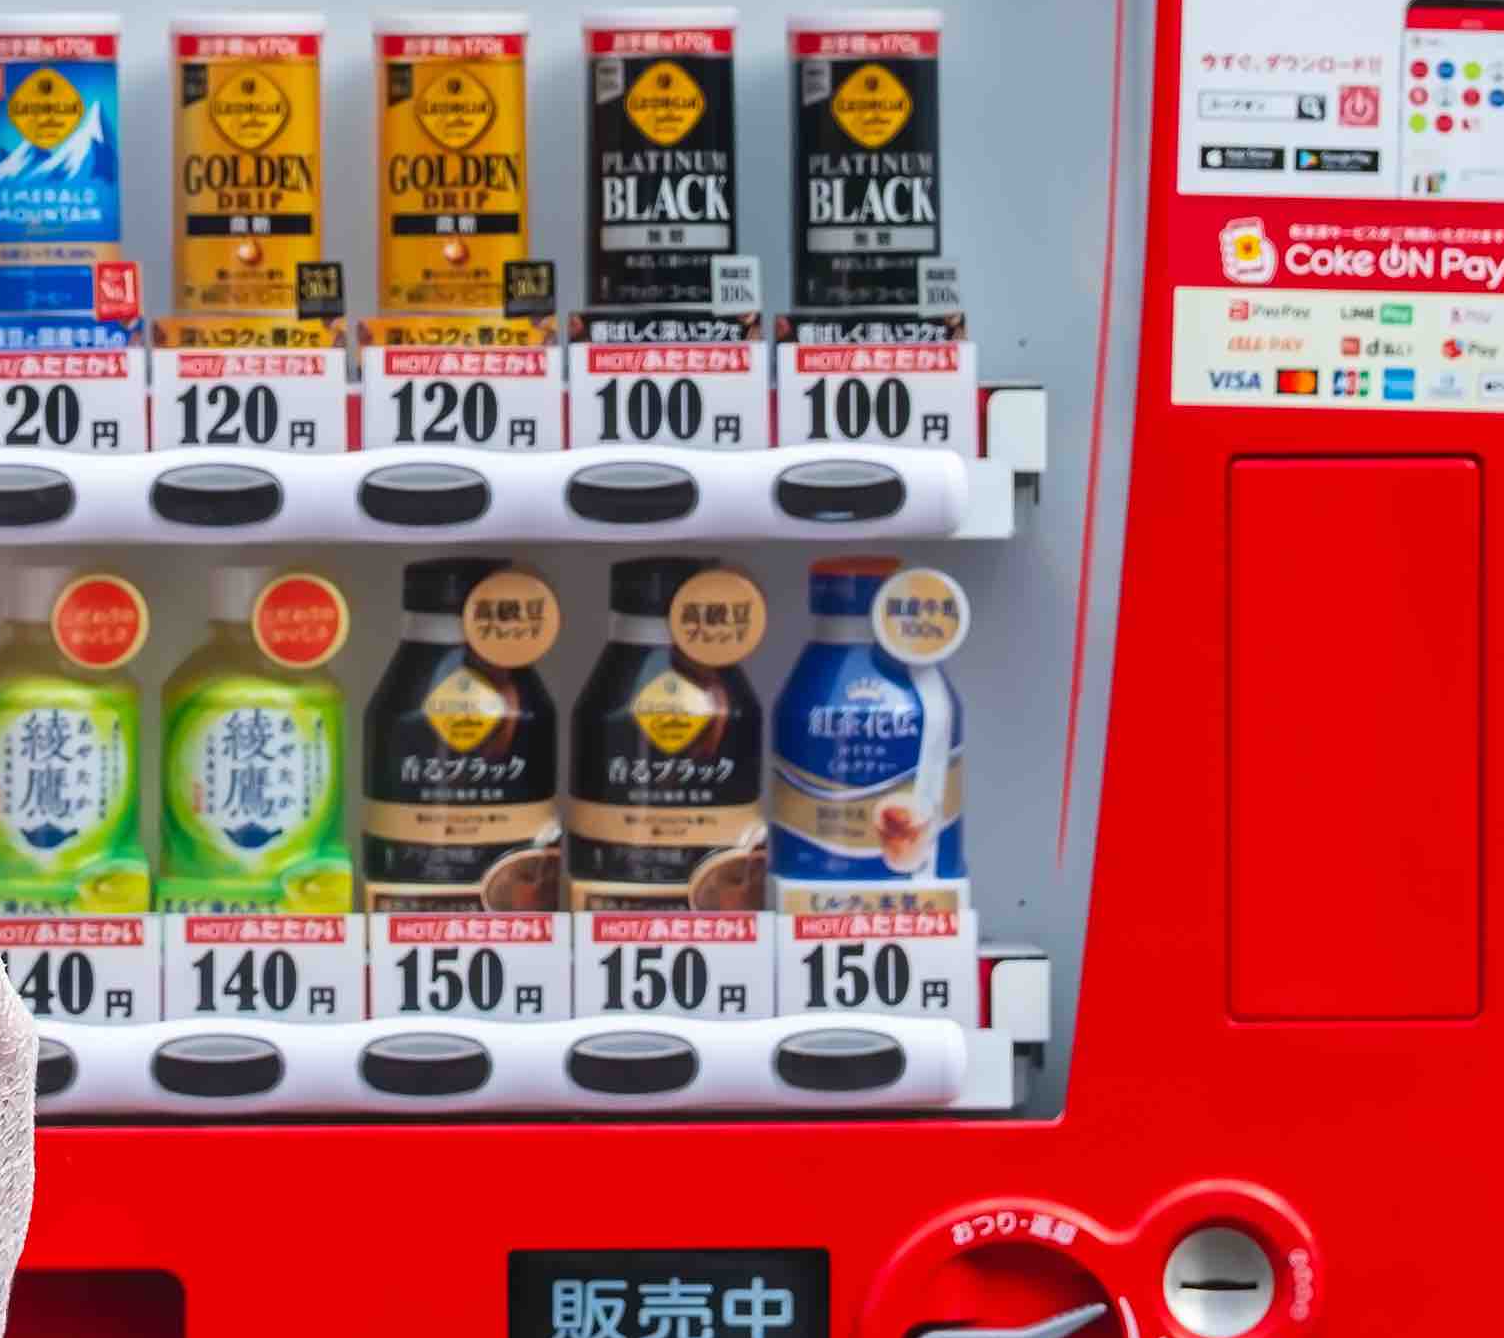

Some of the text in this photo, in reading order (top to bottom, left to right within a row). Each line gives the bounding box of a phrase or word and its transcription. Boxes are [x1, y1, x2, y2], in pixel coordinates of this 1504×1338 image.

[183, 153, 313, 196] GOLDEN
[389, 153, 519, 196] GOLDEN
[601, 151, 728, 174] PLATINUM
[808, 153, 934, 175] PLATINUM
[0, 189, 97, 204] EMERALD
[217, 192, 283, 209] DRIP
[423, 192, 488, 209] DRIP
[602, 175, 731, 221] BLACK
[808, 176, 936, 223] BLACK
[1284, 242, 1376, 277] Coke
[1378, 240, 1434, 279] ON
[590, 322, 741, 343] 香ばしく深いコクで
[798, 322, 946, 343] 香ばしく深いコクで
[1208, 370, 1263, 391] VISA
[472, 597, 547, 622] 高級豆
[680, 600, 753, 626] 高級豆
[478, 622, 544, 642] ブレンド
[685, 626, 750, 645] ブレンド
[807, 705, 920, 740] 紅茶花伝
[19, 709, 74, 819] 綾鷹
[221, 708, 276, 818] 綾鷹
[400, 754, 527, 784] 香るブラック
[607, 755, 736, 785] 香るブラック
[191, 919, 345, 942] HOT/あたたかい
[395, 919, 552, 941] HOT/あたたかい
[598, 917, 757, 941] HOT/あたたかい
[801, 912, 959, 938] HOT/あたたかい
